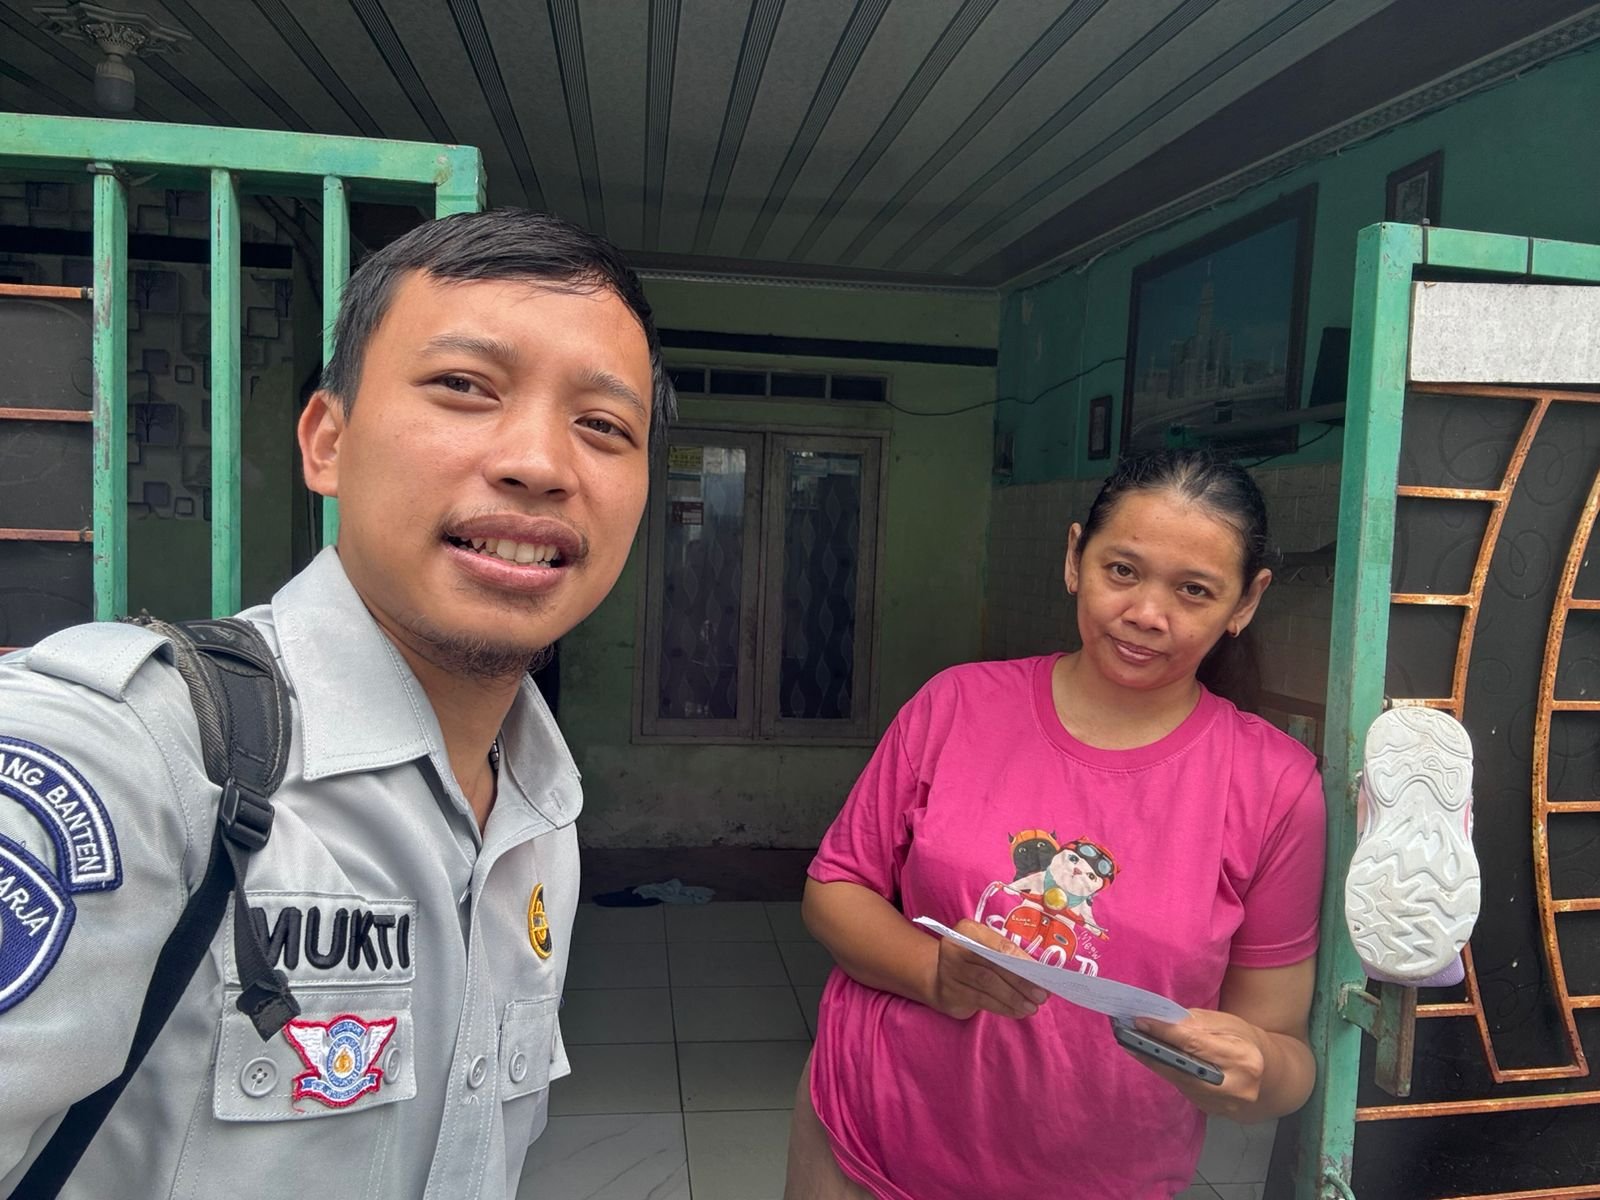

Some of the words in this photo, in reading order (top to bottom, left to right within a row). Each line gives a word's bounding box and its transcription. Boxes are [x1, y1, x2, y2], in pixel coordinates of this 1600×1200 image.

[46, 785, 102, 872] BANTEN
[0, 866, 49, 937] ARJA
[249, 906, 410, 971] MUKTI
